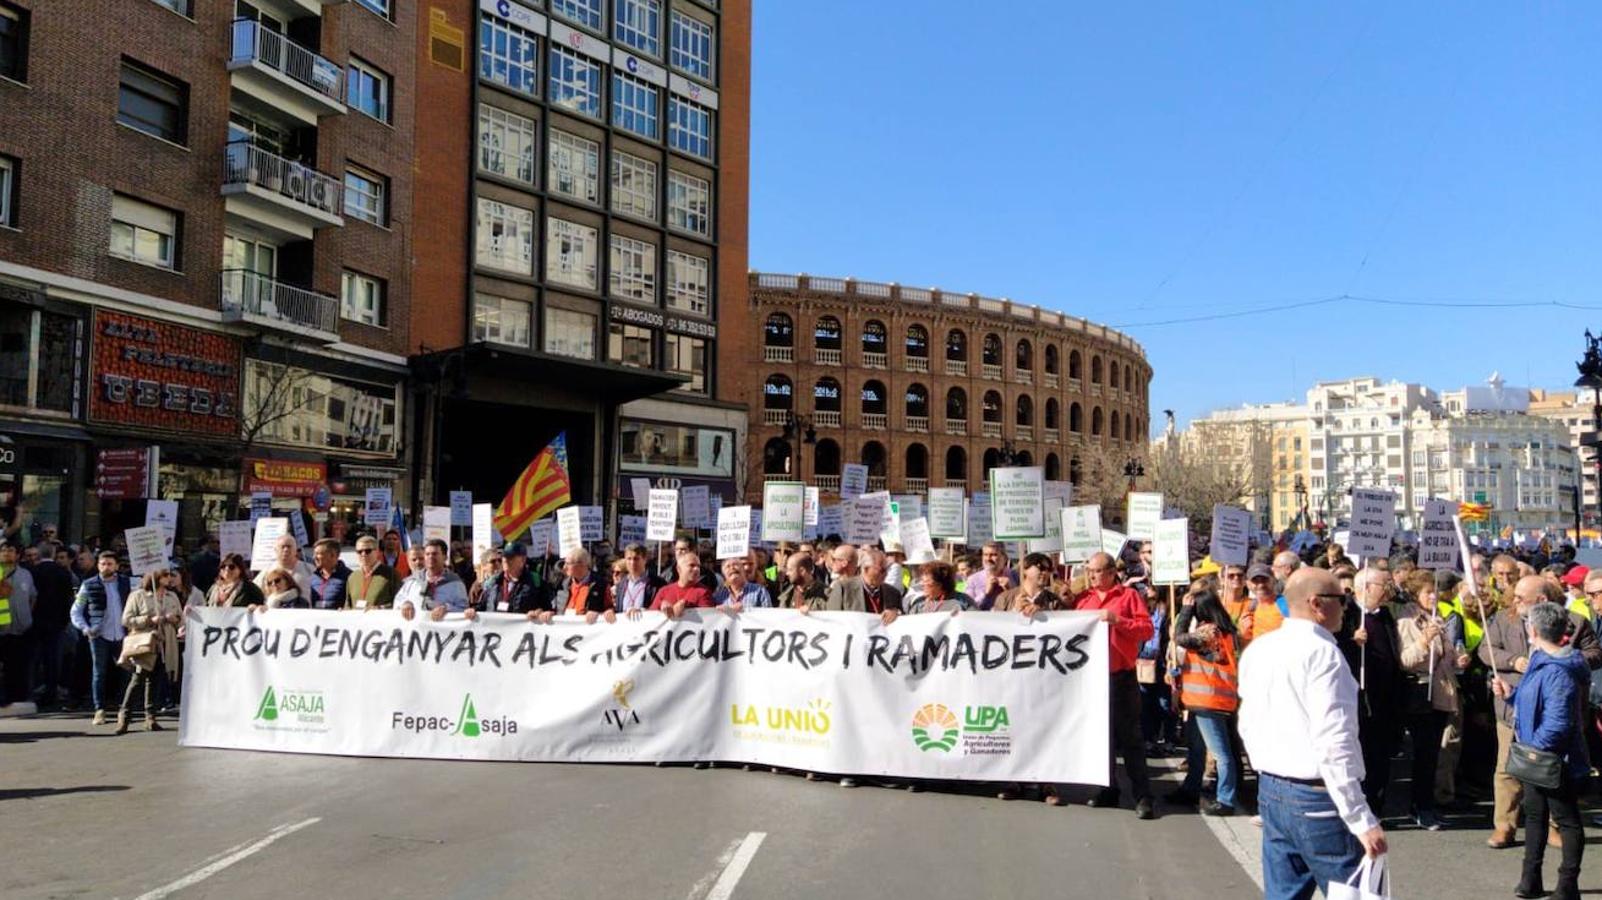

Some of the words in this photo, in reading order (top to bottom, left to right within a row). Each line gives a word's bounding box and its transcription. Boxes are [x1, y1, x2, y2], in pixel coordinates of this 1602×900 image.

[623, 308, 664, 327] ABOGADOS
[104, 373, 235, 418] UBEDA
[202, 626, 281, 660] PROU
[290, 625, 502, 669] D'ENGANYAR
[511, 632, 584, 669] ALS
[843, 633, 853, 669] I
[867, 633, 1090, 676] RAMADERS
[280, 694, 324, 713] ASAJA
[731, 703, 760, 726] LA
[602, 709, 640, 731] AVA
[963, 706, 1009, 731] UPA
[963, 740, 1011, 748] Agricultores
